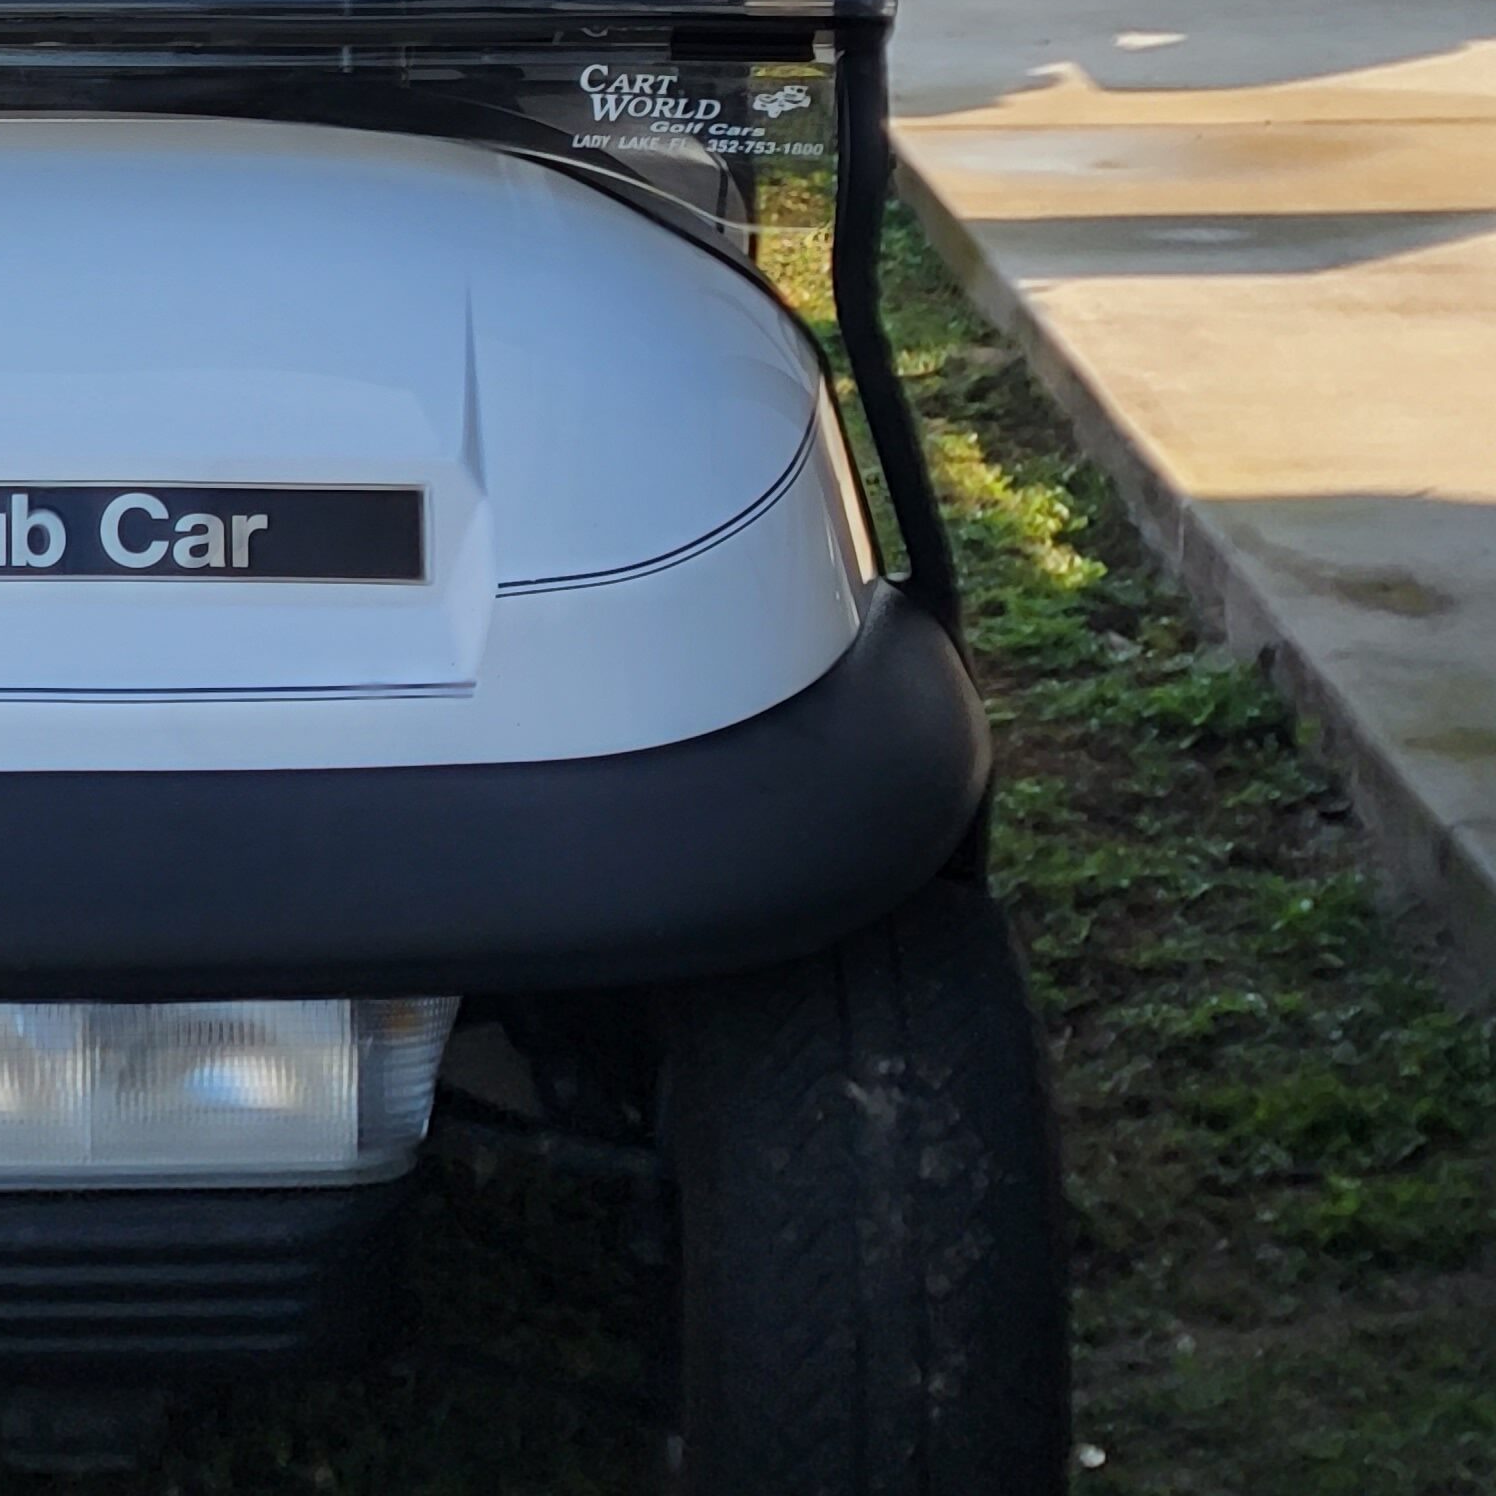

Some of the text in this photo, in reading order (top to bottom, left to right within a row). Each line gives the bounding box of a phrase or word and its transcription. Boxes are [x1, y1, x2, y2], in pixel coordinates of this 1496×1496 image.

[579, 64, 677, 94] CART
[589, 93, 721, 122] WORLD
[572, 134, 611, 149] LADY
[618, 136, 660, 151] LAKE
[650, 120, 766, 137] Golf Cars
[100, 492, 267, 569] Car
